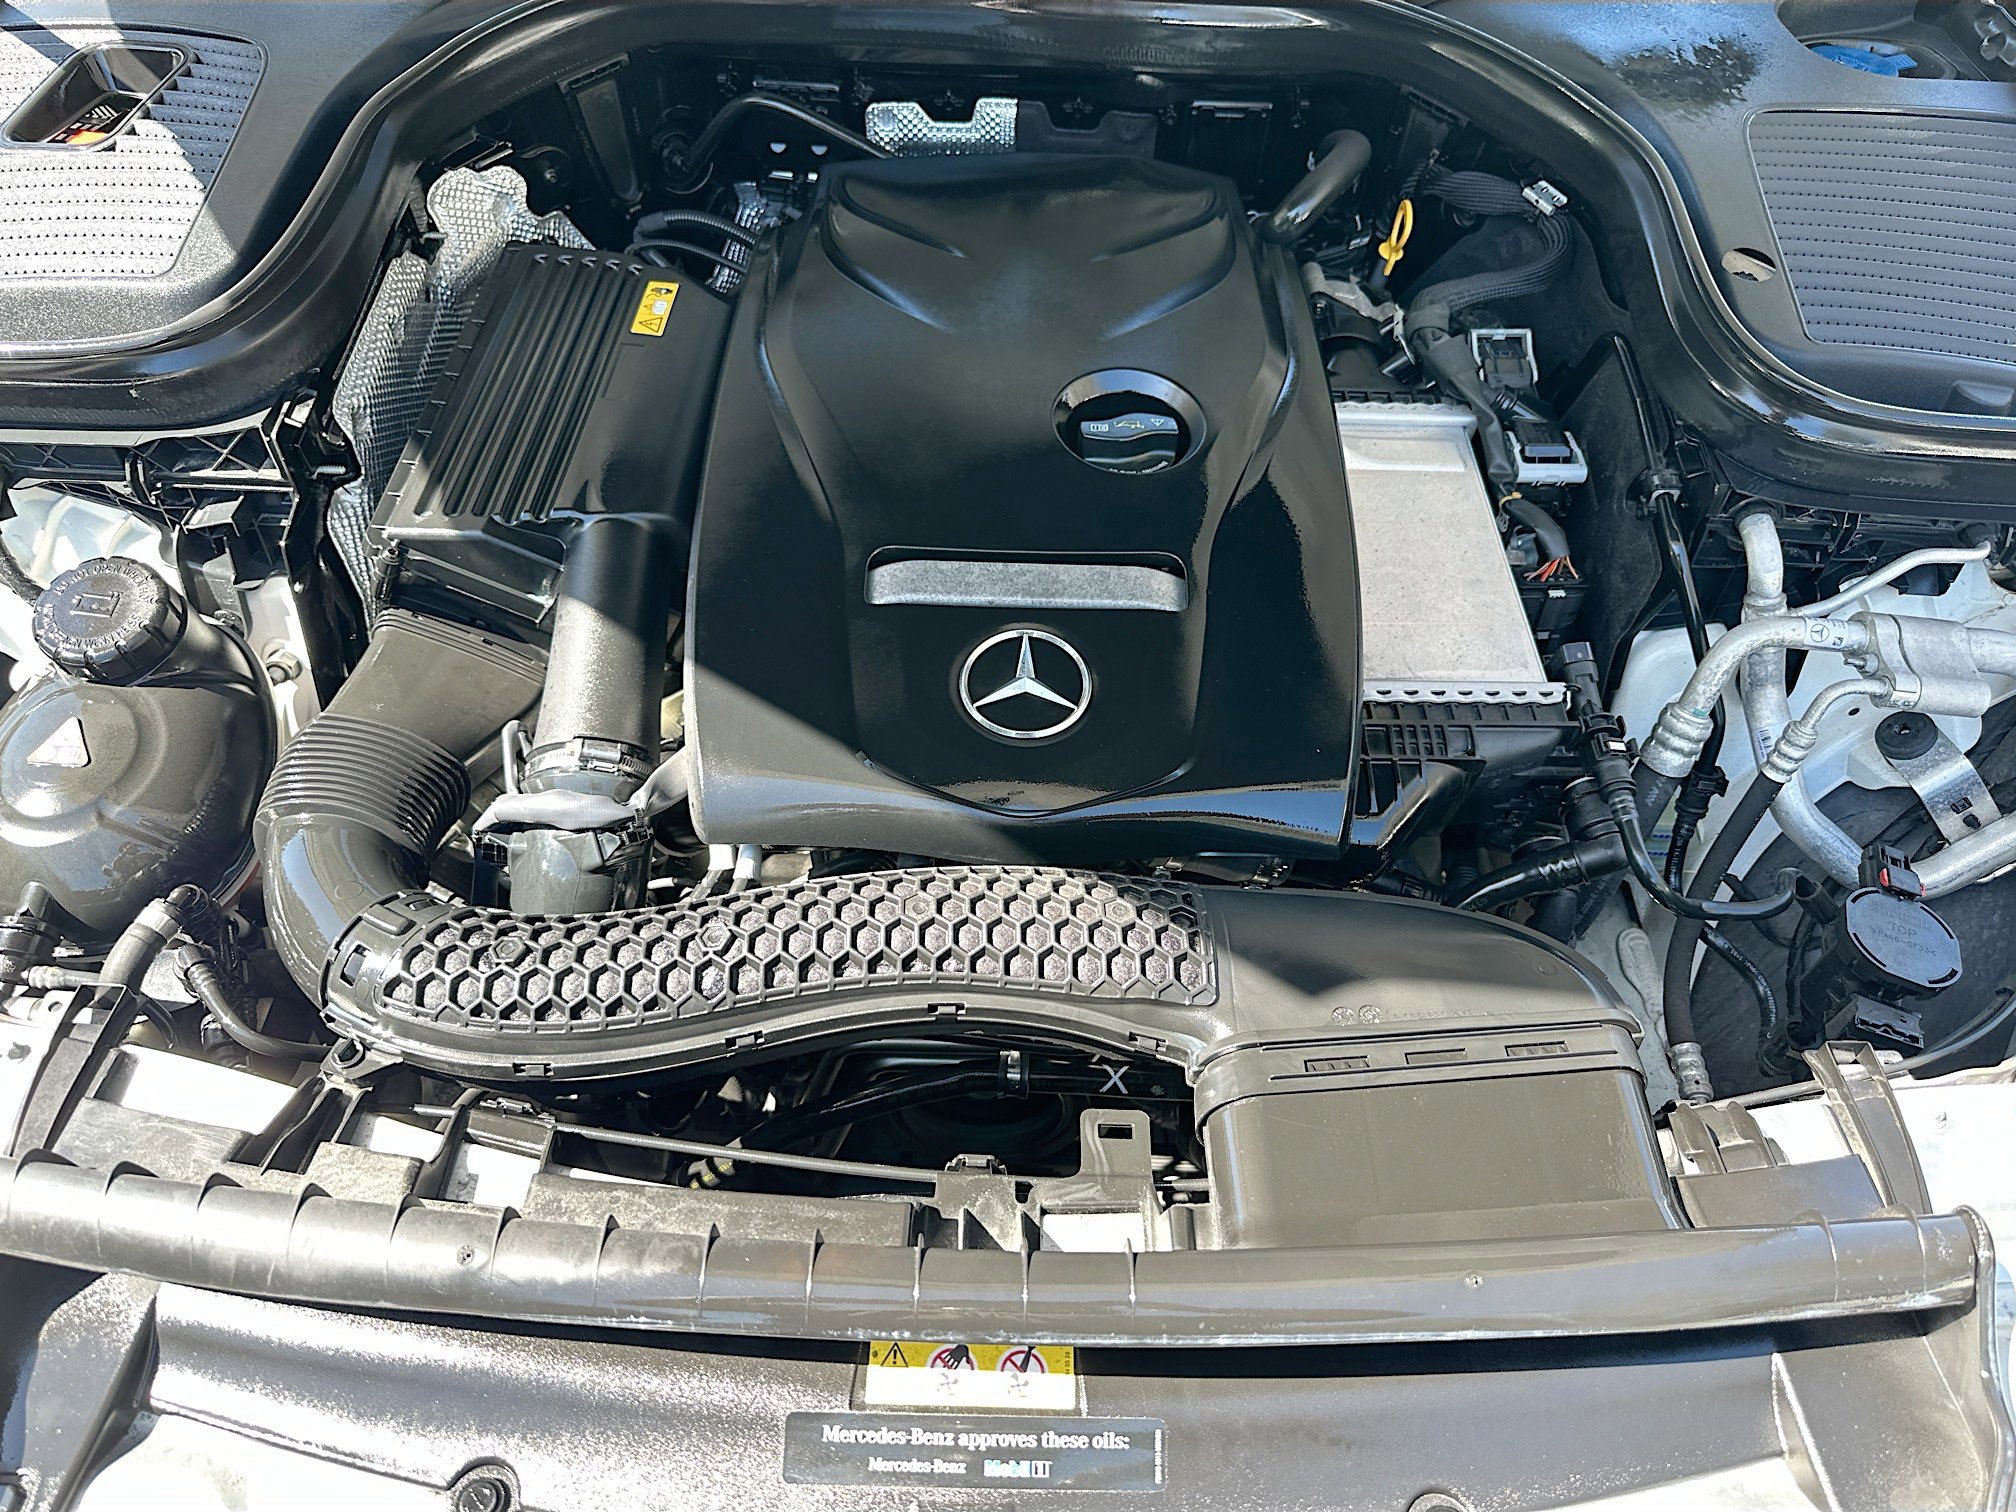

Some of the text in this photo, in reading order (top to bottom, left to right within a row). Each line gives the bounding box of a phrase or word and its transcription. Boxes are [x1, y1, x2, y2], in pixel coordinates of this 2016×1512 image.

[71, 568, 92, 584] NOT
[94, 563, 121, 576] OPEN
[1889, 922, 1917, 937] TOP
[821, 1424, 1131, 1451] Mercedes-Benz approves these oils:
[867, 1456, 967, 1474] Mercedes-Benz
